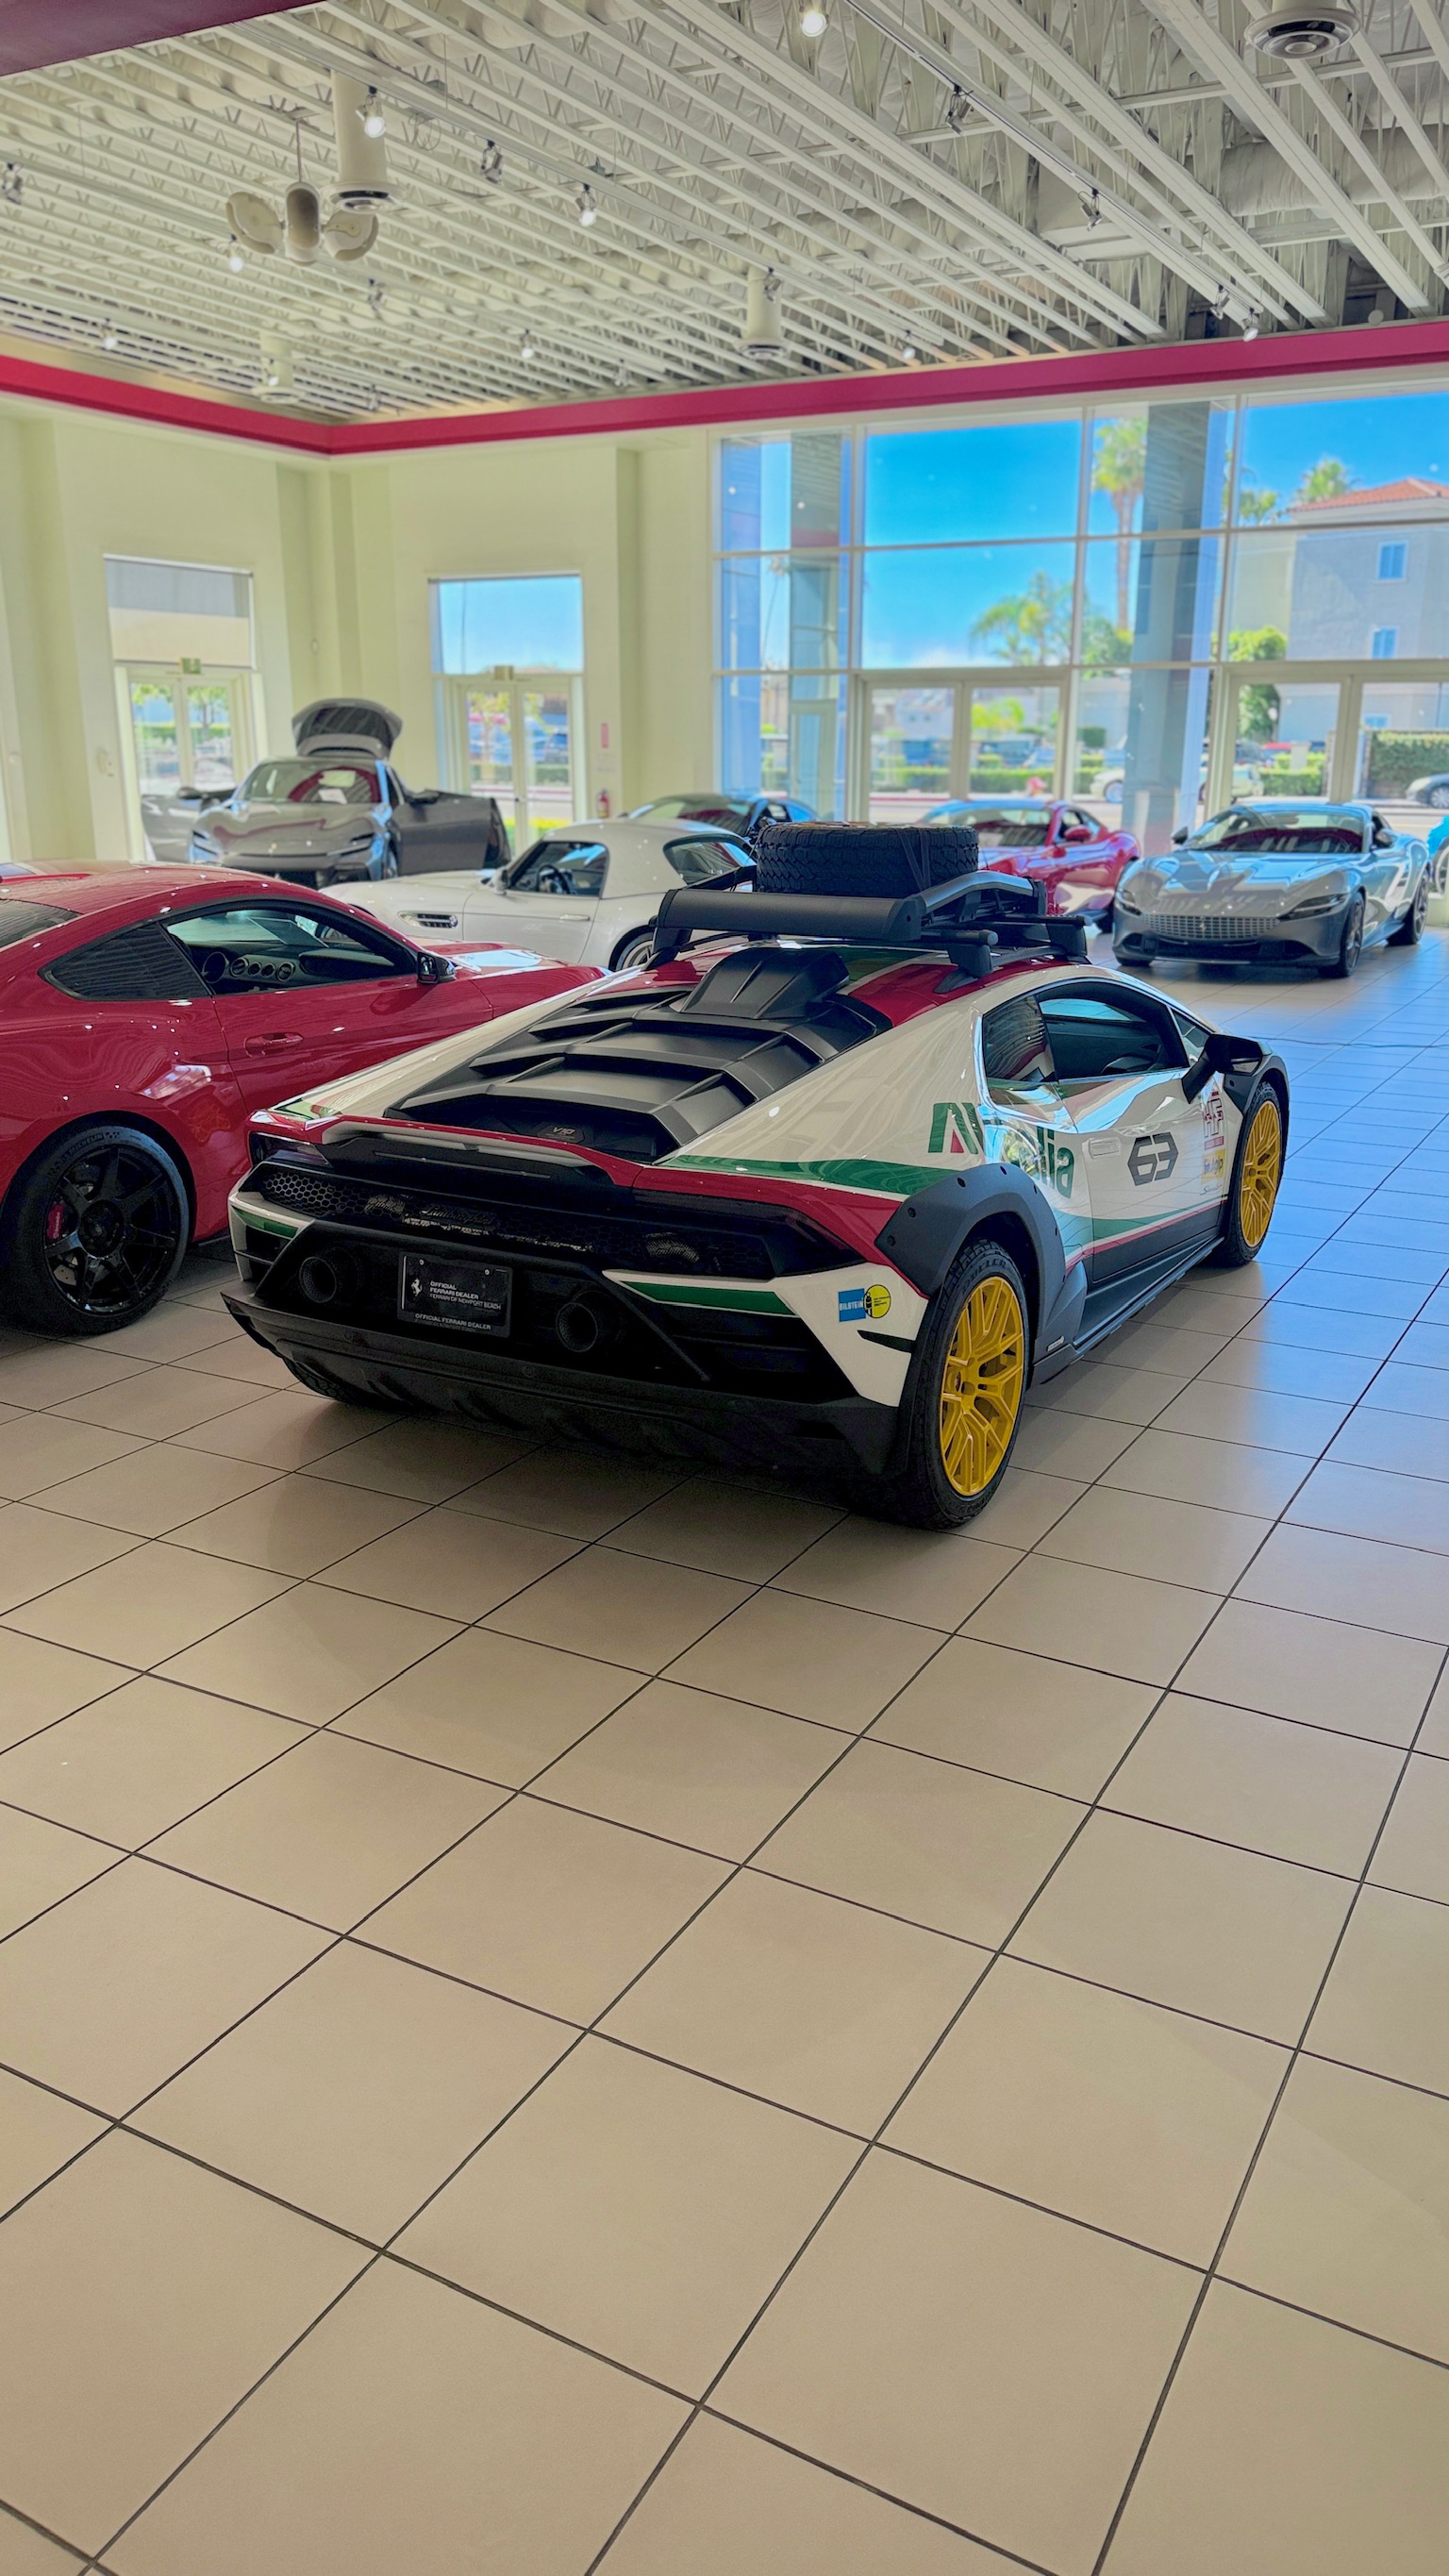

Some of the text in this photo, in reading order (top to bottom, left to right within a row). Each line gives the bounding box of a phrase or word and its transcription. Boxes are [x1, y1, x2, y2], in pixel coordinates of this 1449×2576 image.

[553, 1127, 575, 1135] V10
[1128, 1132, 1178, 1185] 63
[430, 1280, 457, 1291] OFFICIAL
[430, 1288, 479, 1299] FERRARI DEALER
[430, 1294, 450, 1302] FERRARI
[458, 1297, 484, 1307] NEWPORT
[484, 1301, 501, 1311] BEACH
[415, 1313, 441, 1322] OFFICIAL
[442, 1316, 467, 1327] FERRARI
[467, 1322, 491, 1330] DEALER
